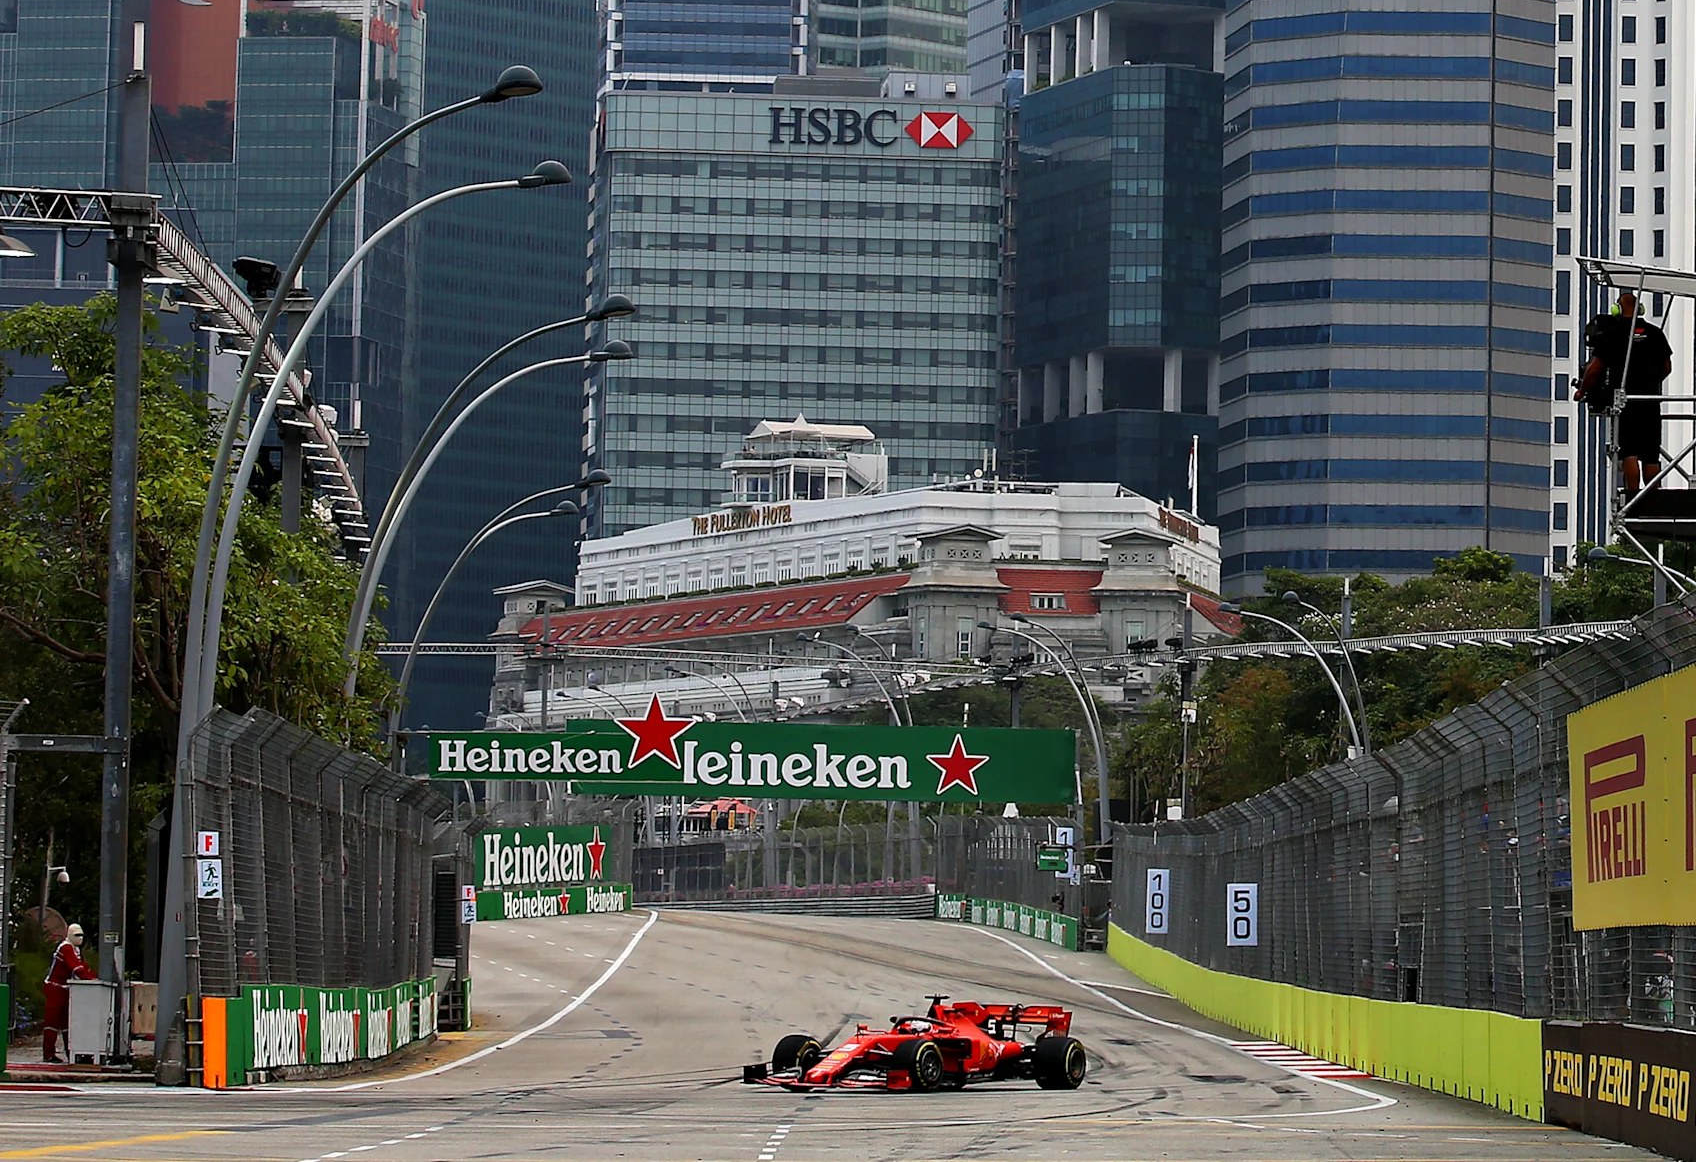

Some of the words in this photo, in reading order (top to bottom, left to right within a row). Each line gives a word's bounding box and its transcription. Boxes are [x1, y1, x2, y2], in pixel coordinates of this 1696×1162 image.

[768, 107, 898, 147] HSBC
[692, 516, 709, 536] THE
[762, 504, 793, 526] HOTEL
[436, 740, 623, 774] Heineken
[1584, 734, 1646, 883] PIRELLI
[205, 835, 213, 852] F
[483, 832, 585, 886] Heineken
[503, 890, 558, 919] Heineken
[586, 886, 624, 913] Heineken
[1151, 874, 1164, 928] 100
[1233, 890, 1251, 939] 50
[253, 989, 299, 1068] Heineken
[988, 1019, 997, 1035] 5
[1545, 1050, 1552, 1090] P
[1553, 1050, 1583, 1097] ZERO
[1587, 1054, 1597, 1099] P
[1598, 1055, 1633, 1107] ZERO
[1637, 1063, 1648, 1111] P
[1649, 1065, 1690, 1122] ZERO
